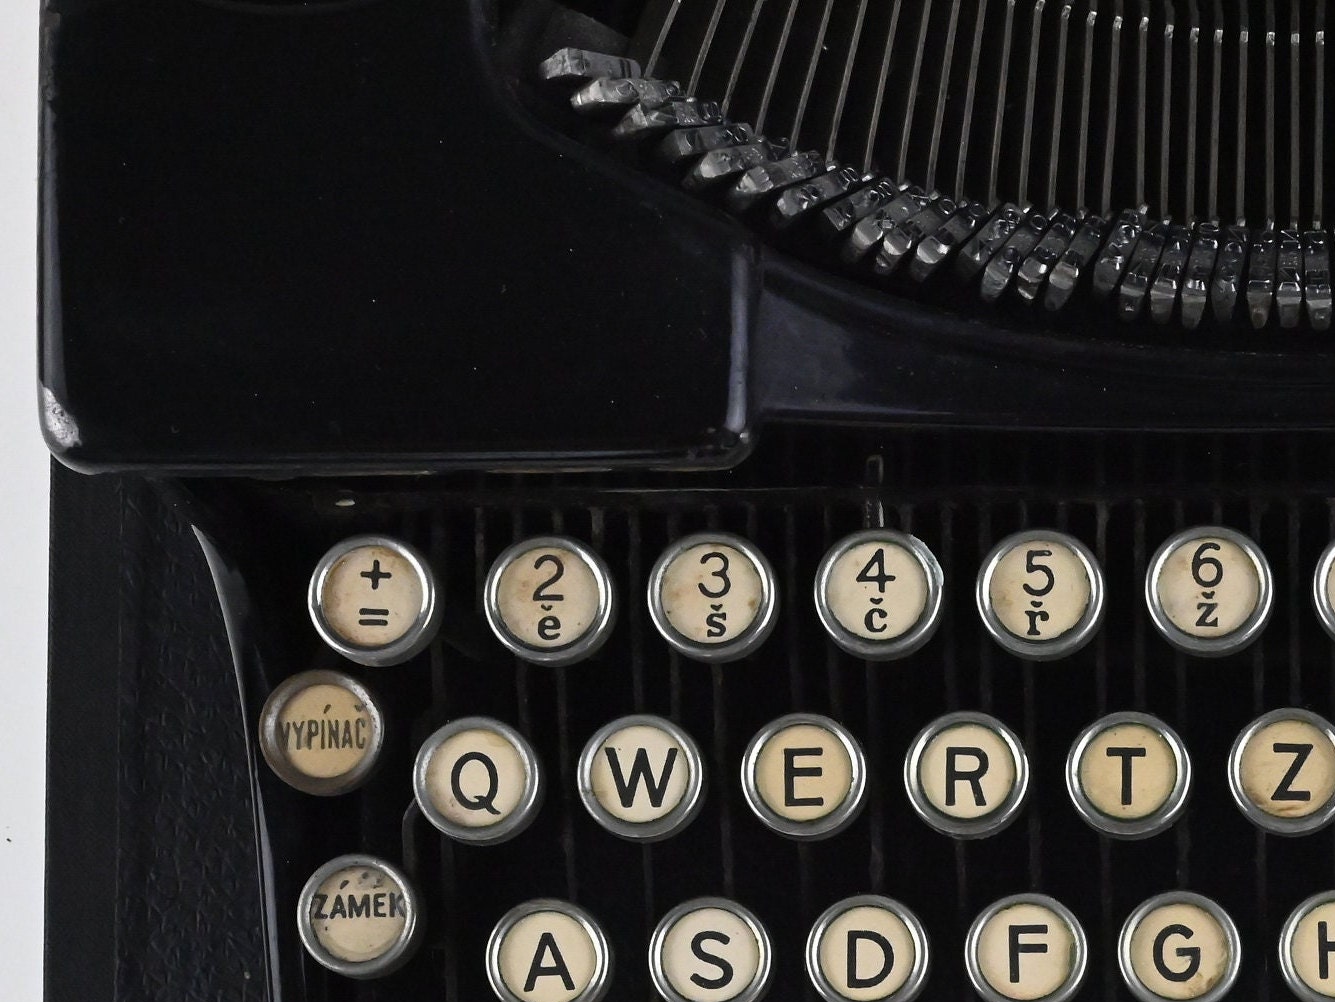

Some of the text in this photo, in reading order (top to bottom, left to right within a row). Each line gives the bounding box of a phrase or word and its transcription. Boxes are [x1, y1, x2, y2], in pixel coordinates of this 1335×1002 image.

[359, 559, 392, 590] +
[533, 554, 564, 602] 2
[698, 551, 731, 599] 3
[856, 548, 896, 594] 4
[1023, 549, 1054, 597] 5
[1191, 543, 1223, 588] 6
[358, 607, 390, 627] =
[537, 604, 561, 640] ě
[705, 603, 727, 637] š
[864, 597, 888, 633] č
[1024, 600, 1050, 635] ř
[1195, 590, 1219, 628] ž
[451, 751, 502, 816] Q
[604, 746, 678, 809] W
[783, 746, 825, 807] E
[945, 746, 990, 807] R
[1105, 746, 1147, 806] T
[1270, 742, 1314, 802] Z
[523, 932, 576, 993] A
[689, 930, 734, 990] S
[846, 930, 895, 989] D
[1008, 924, 1049, 984] F
[1152, 923, 1201, 983] G
